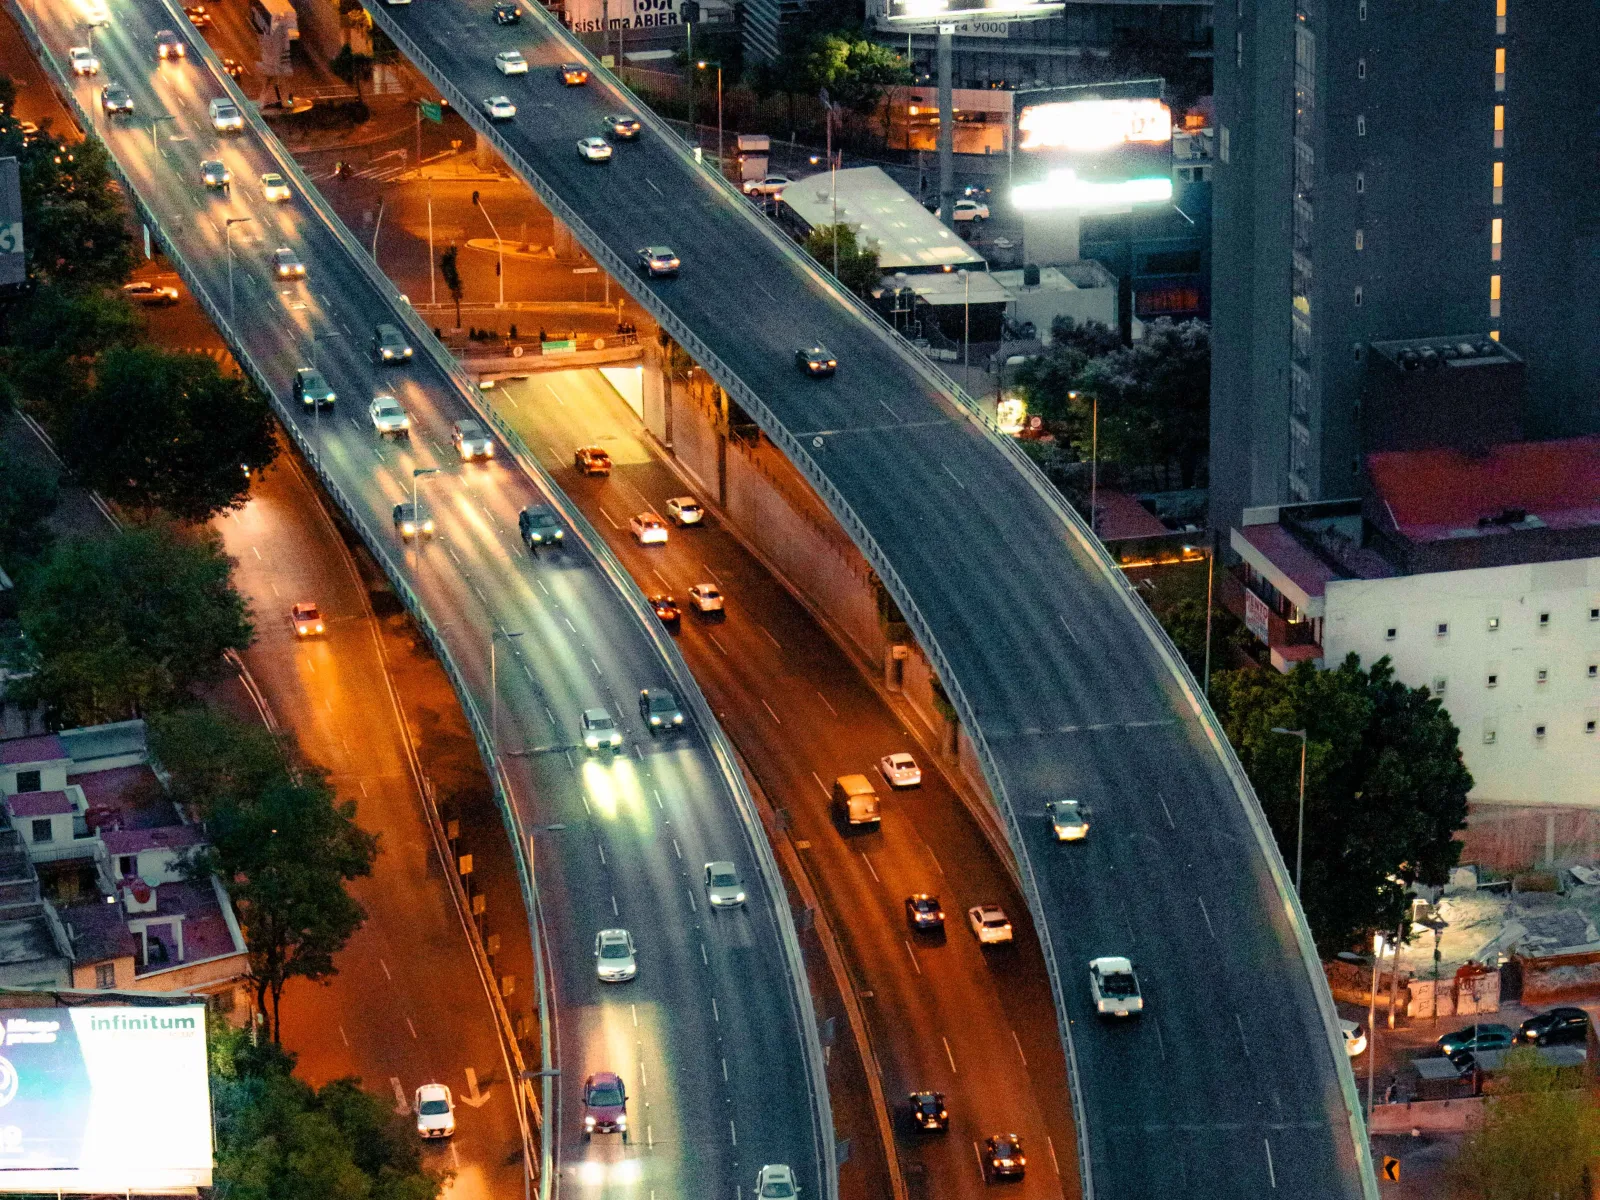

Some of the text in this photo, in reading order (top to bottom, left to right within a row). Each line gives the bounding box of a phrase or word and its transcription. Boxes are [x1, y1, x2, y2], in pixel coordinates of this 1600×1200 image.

[575, 17, 630, 32] sistma
[974, 22, 1006, 34] 9000
[91, 1015, 195, 1030] infinitum
